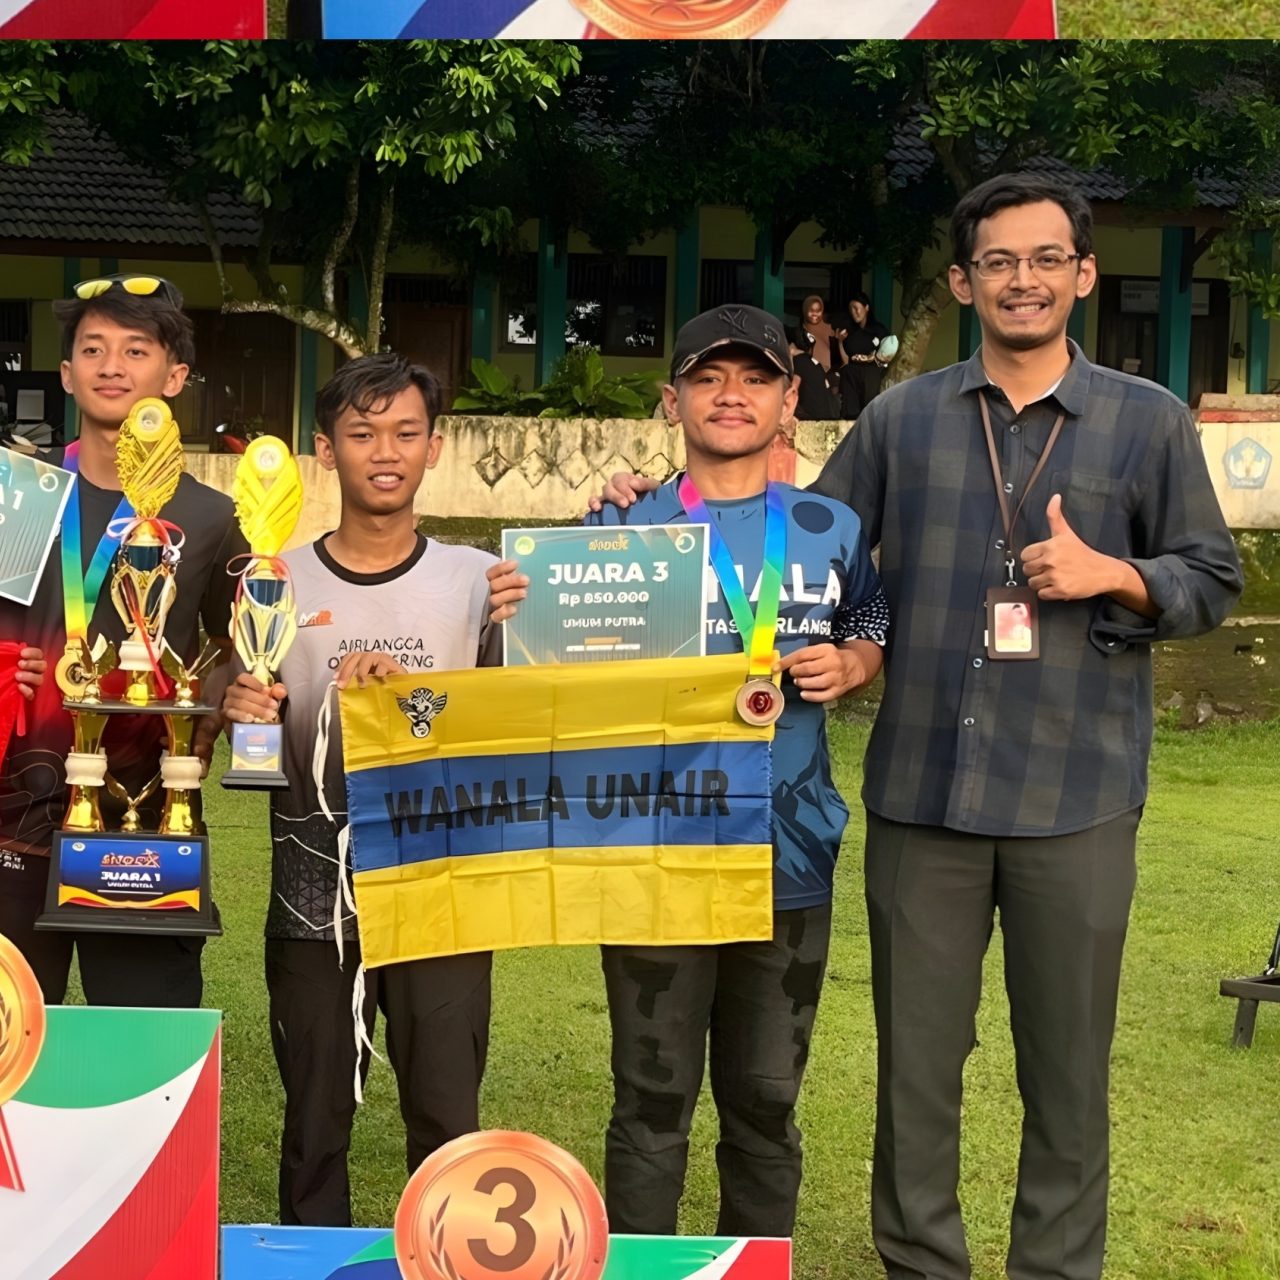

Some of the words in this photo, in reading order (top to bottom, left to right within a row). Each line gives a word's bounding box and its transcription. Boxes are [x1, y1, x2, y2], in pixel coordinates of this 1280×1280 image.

[12, 489, 24, 510] 1
[548, 562, 645, 585] JUARA
[652, 561, 669, 582] 3
[559, 593, 580, 607] Rp
[384, 773, 571, 838] WANALA
[585, 769, 731, 820] UNAIR
[101, 871, 151, 881] JUARA
[154, 873, 160, 882] 1
[467, 1166, 536, 1272] 3
